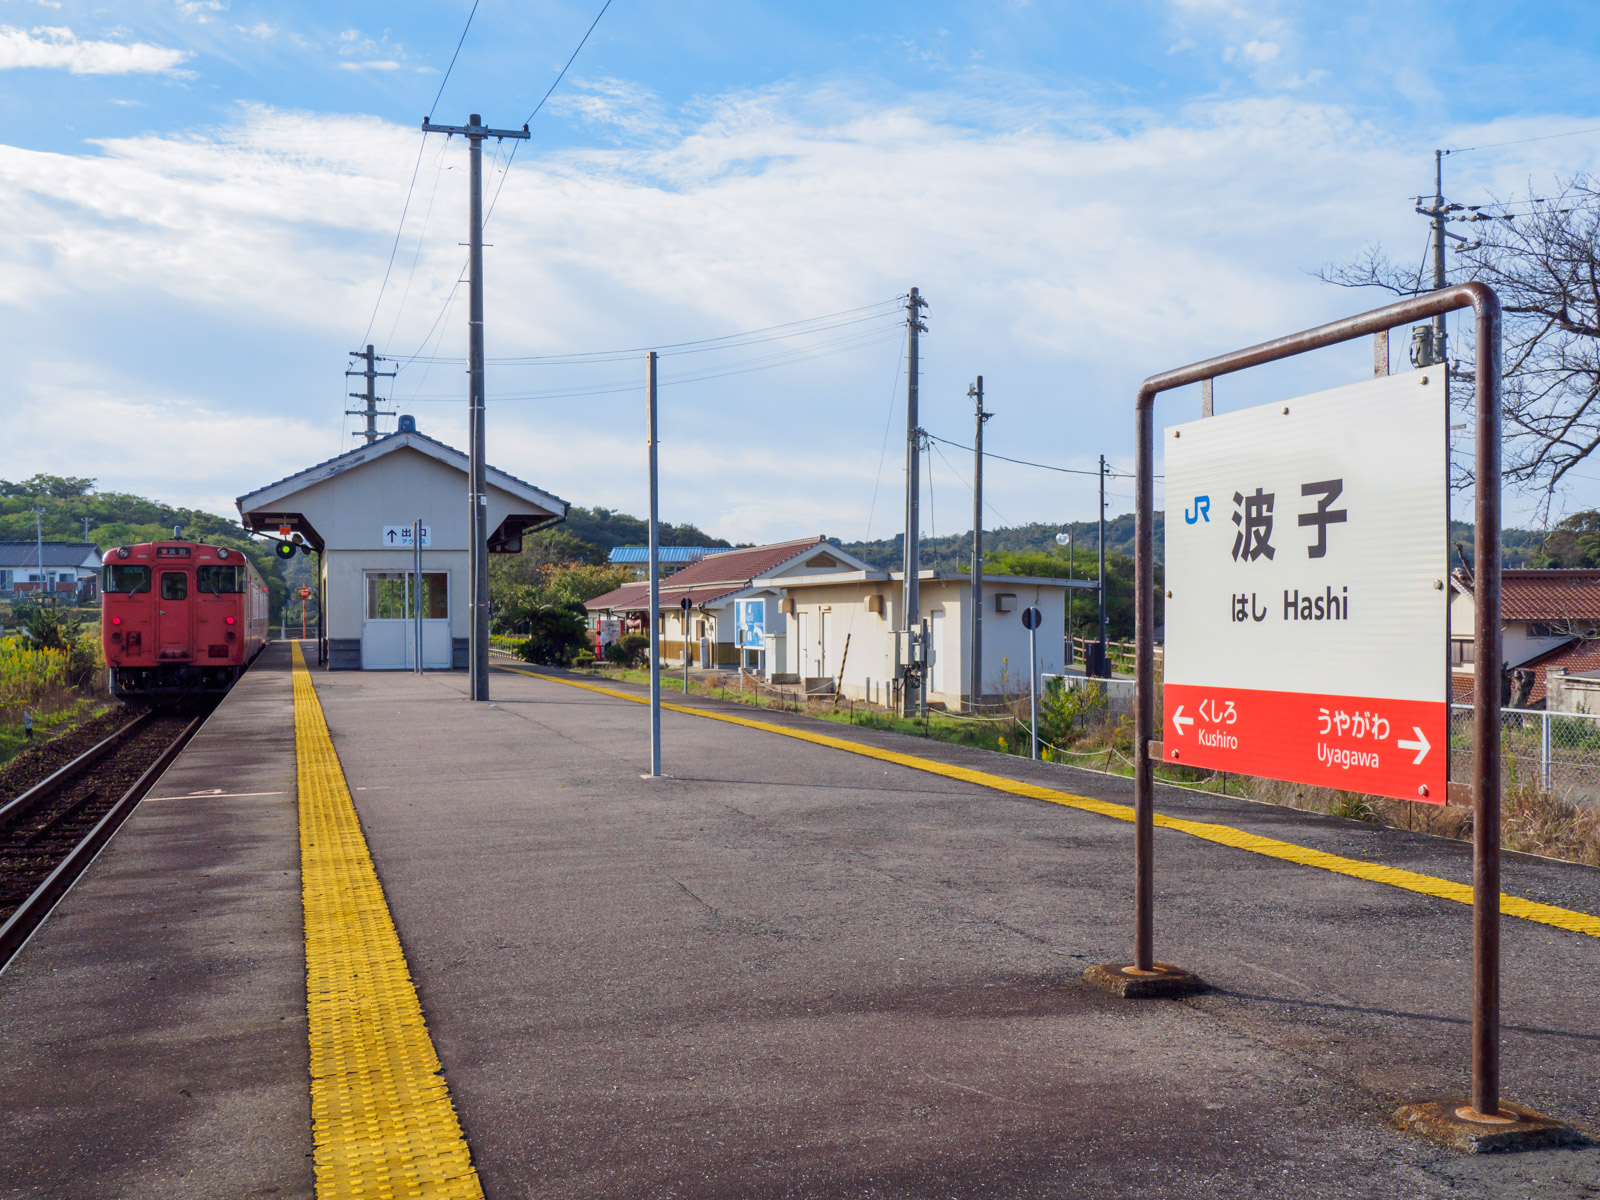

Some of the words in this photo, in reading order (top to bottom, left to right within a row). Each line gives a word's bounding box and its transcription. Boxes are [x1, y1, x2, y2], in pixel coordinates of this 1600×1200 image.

[1185, 496, 1210, 525] JR
[1231, 479, 1347, 562] 波子
[1232, 593, 1267, 622] はし
[1283, 586, 1348, 621] Hashi
[1198, 699, 1237, 725] くしろ
[1317, 707, 1390, 740] うやがわ
[1198, 729, 1238, 750] Kushiro
[1317, 743, 1379, 769] Uyagawa
